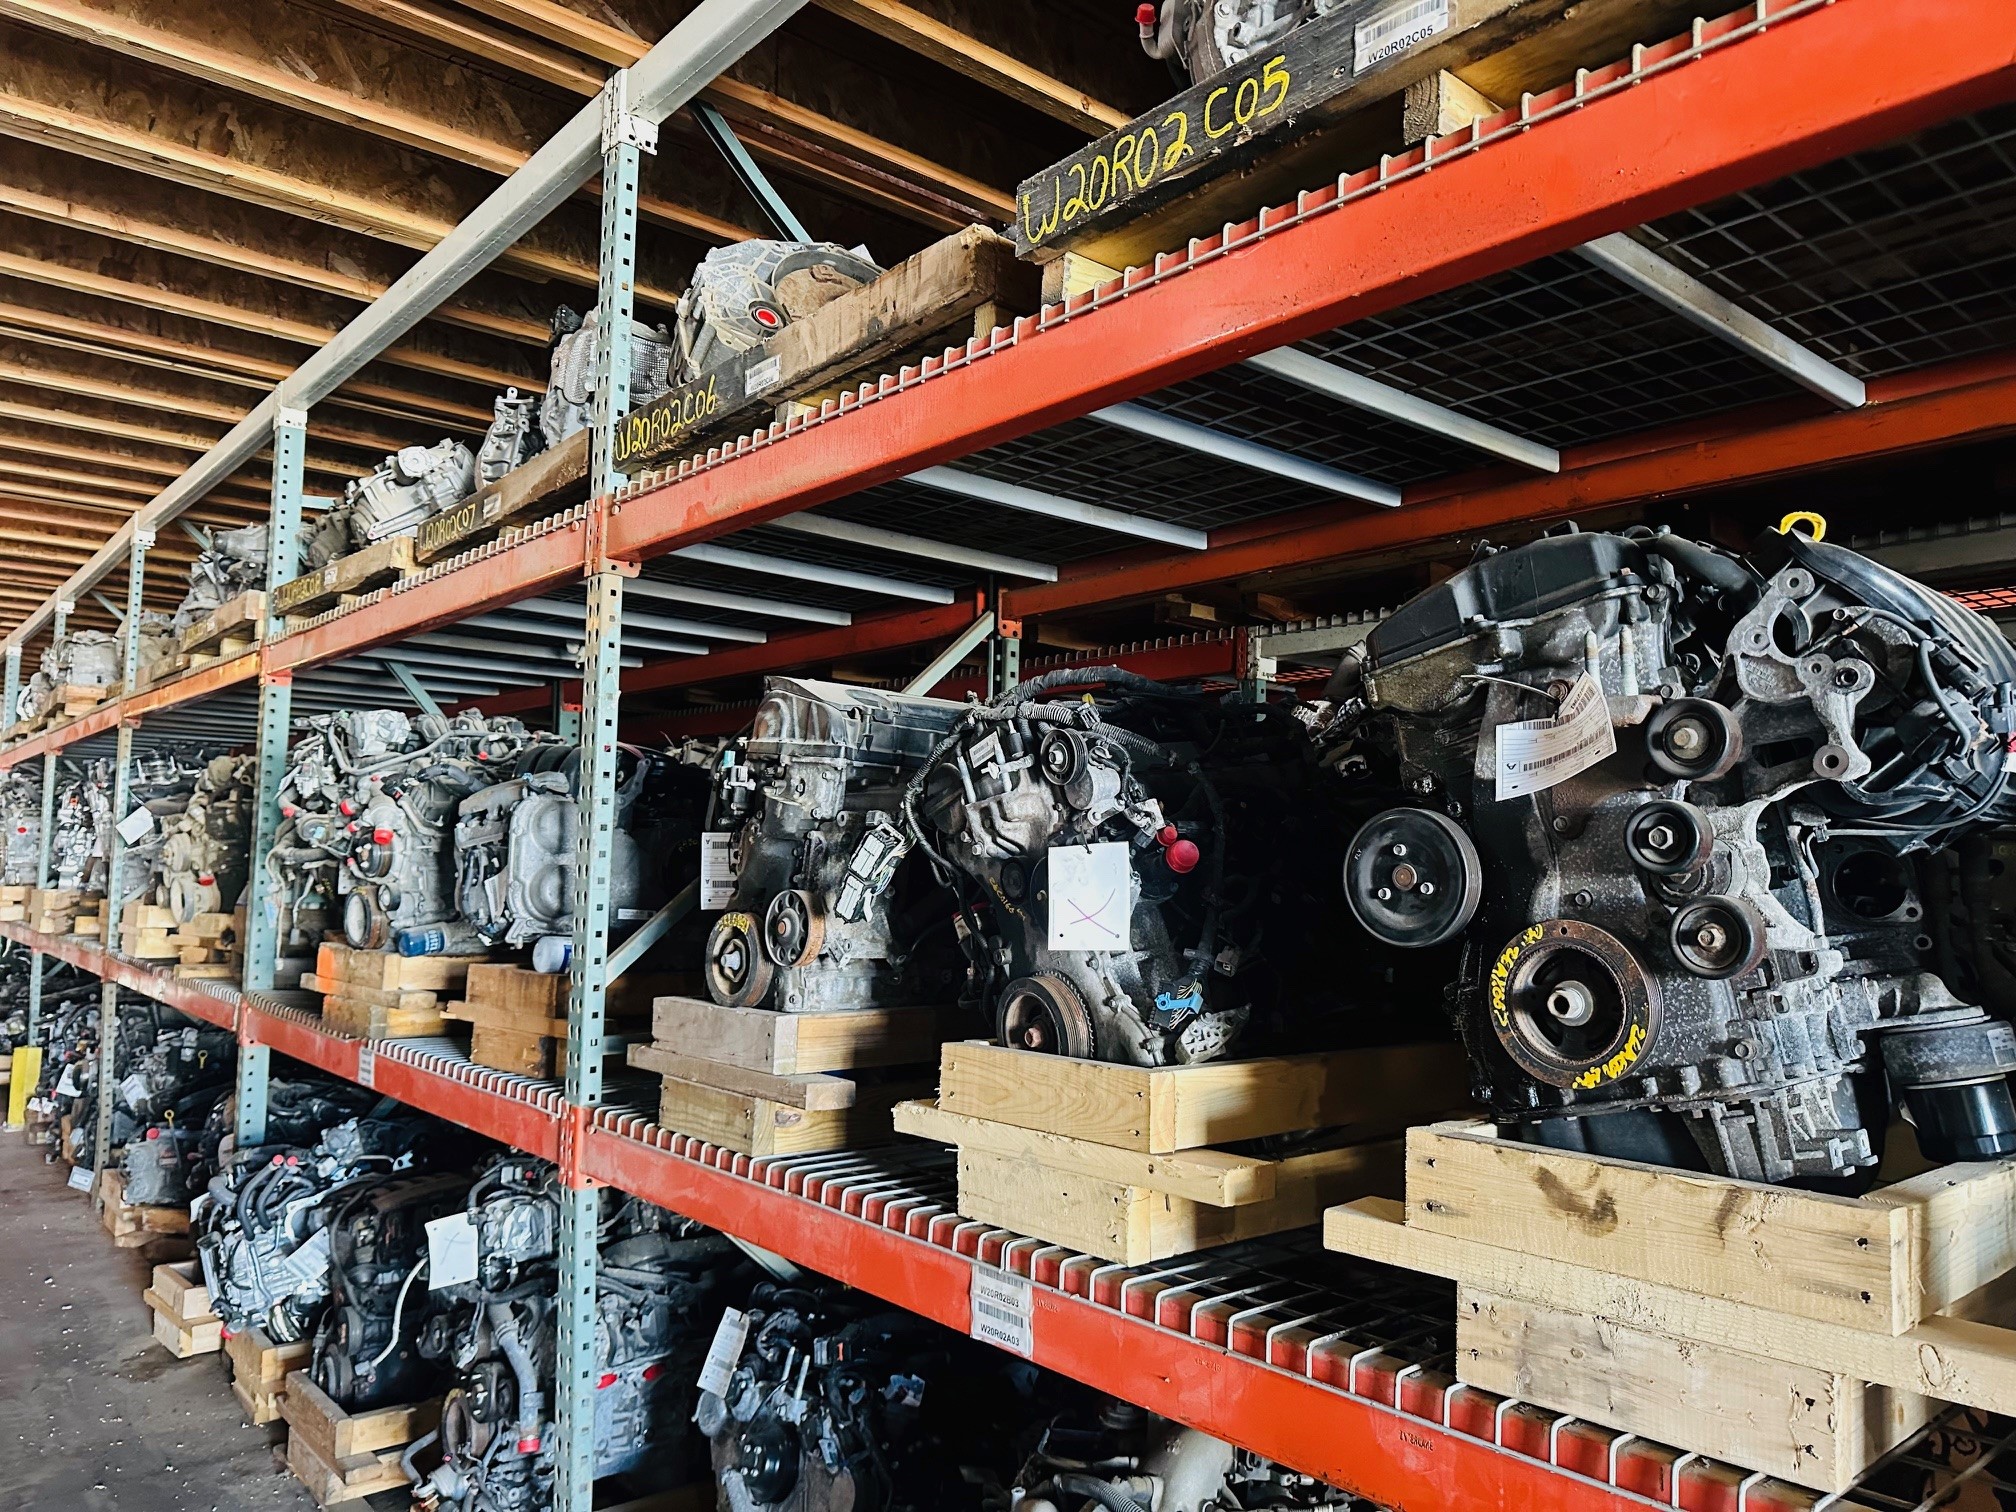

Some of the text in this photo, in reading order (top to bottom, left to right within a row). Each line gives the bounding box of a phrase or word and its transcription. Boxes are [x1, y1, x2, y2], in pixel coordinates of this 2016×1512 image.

[1367, 24, 1434, 64] W20R02C05
[615, 373, 717, 462] W20R02C06
[980, 1285, 1020, 1308] W20R02B03
[980, 1323, 1020, 1347] W20R02A03
